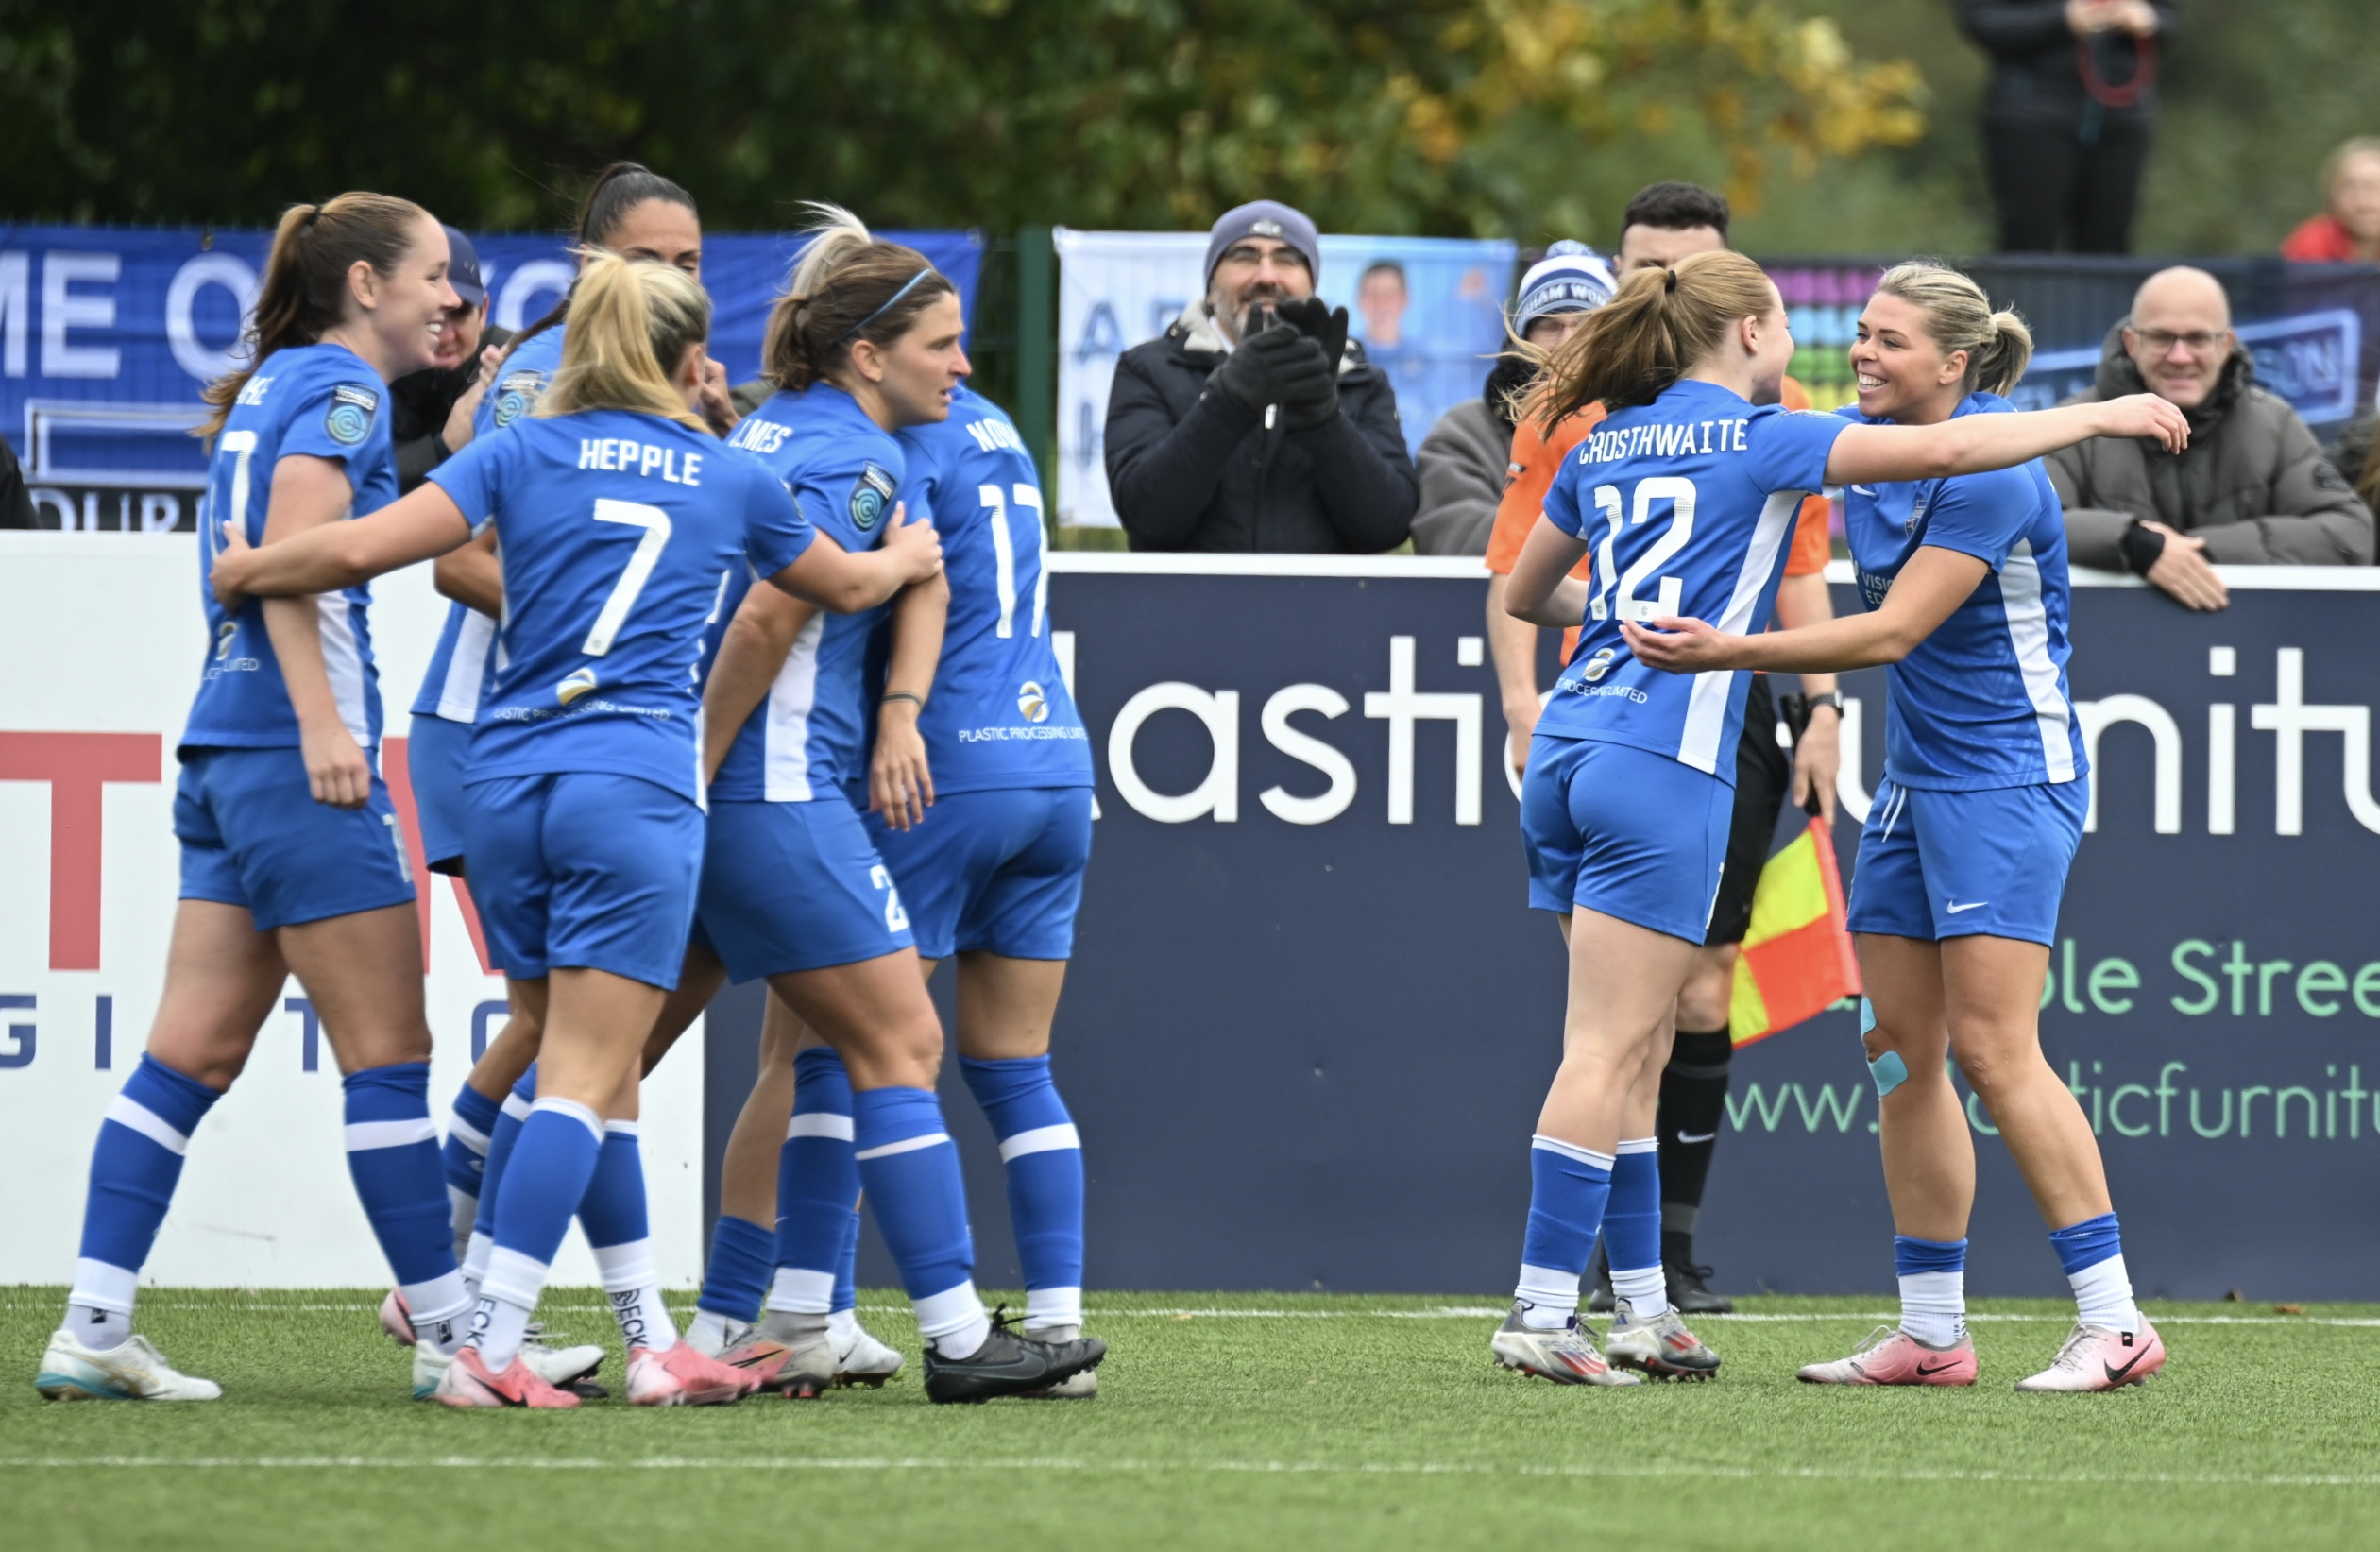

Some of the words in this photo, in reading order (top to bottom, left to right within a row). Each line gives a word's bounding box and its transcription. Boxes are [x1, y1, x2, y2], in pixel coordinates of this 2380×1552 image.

[578, 438, 704, 486] HEPPLE
[1579, 418, 1749, 465] CROSTHWAITE
[581, 498, 672, 657] 7
[978, 483, 1049, 639] 17
[1590, 476, 1697, 623] 12
[959, 727, 1009, 743] PLASTIC
[1009, 725, 1067, 741] PROCESSING
